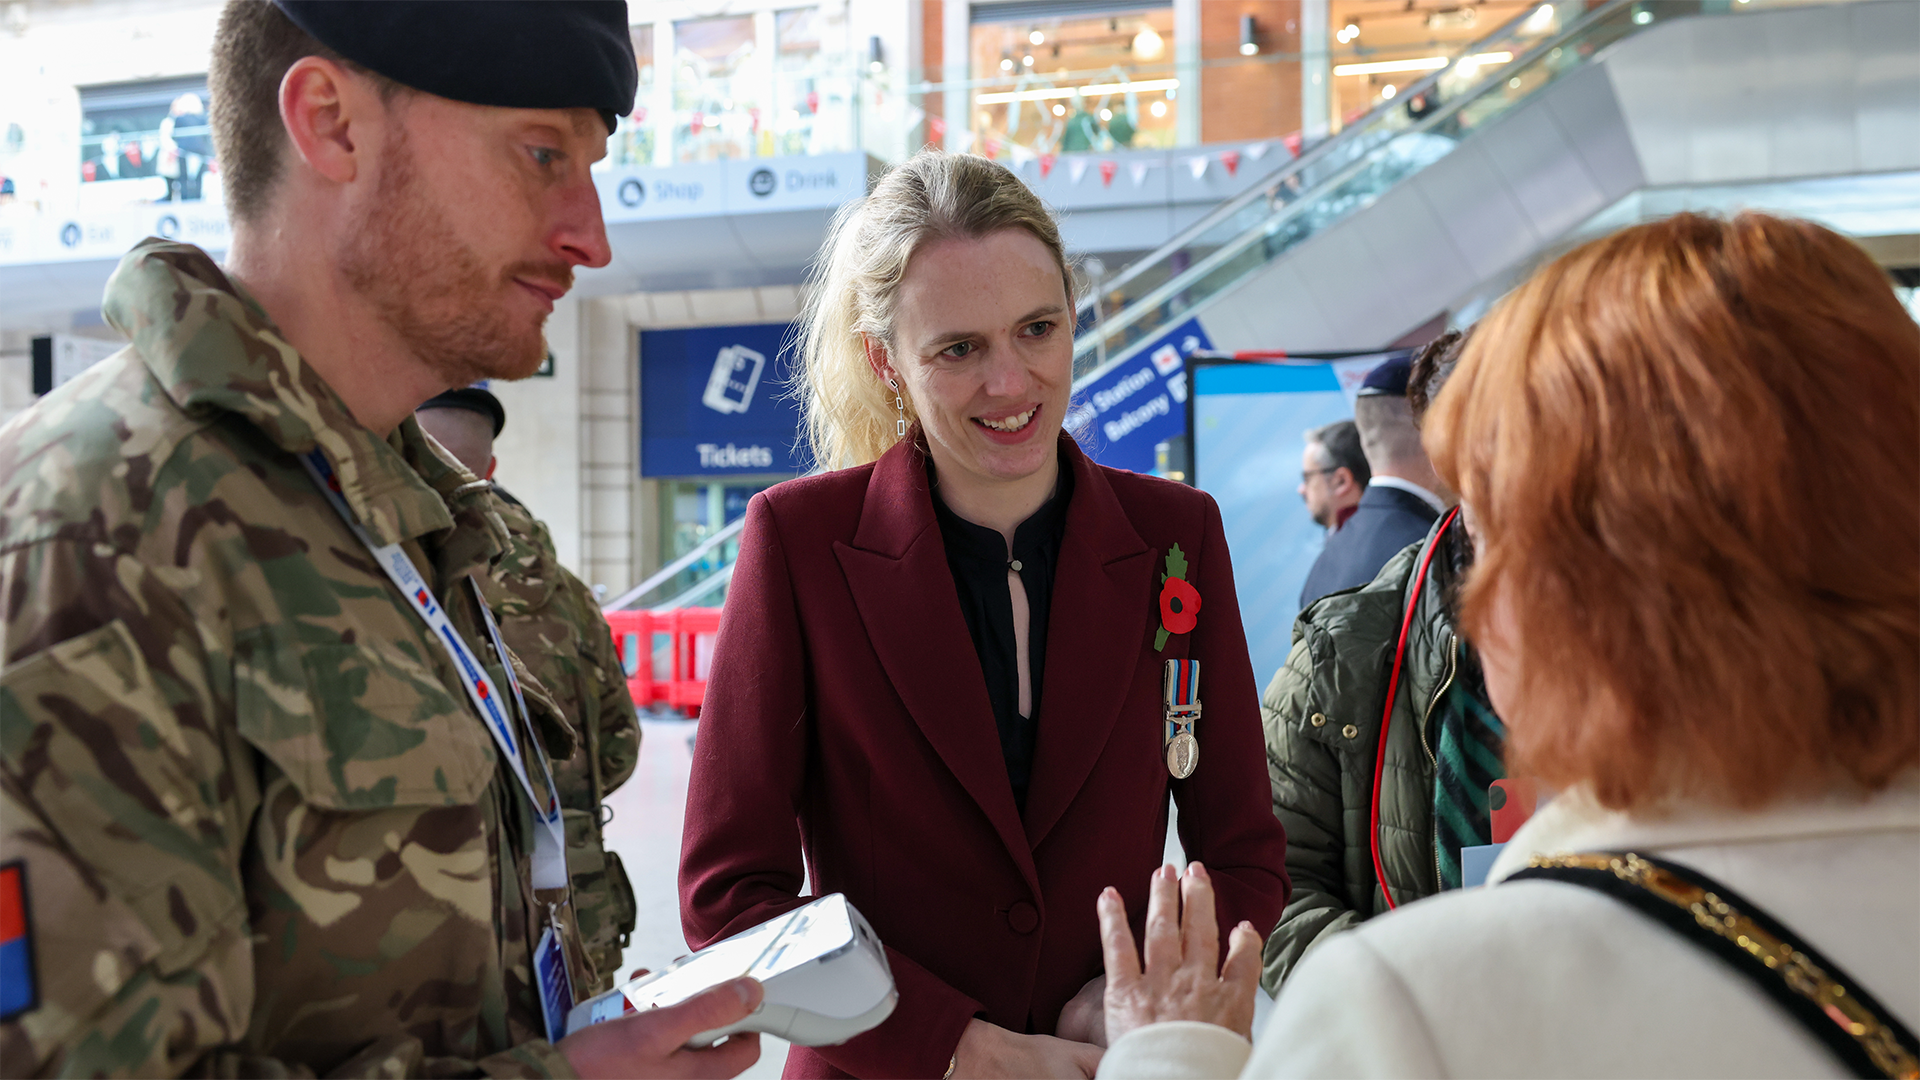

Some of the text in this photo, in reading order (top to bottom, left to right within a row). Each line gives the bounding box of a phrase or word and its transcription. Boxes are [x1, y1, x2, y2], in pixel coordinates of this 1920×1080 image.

[653, 180, 703, 203] Shop
[785, 168, 837, 193] Drink
[1093, 367, 1155, 412] Station
[1104, 394, 1170, 442] Balcony
[696, 443, 772, 468] Tickets
